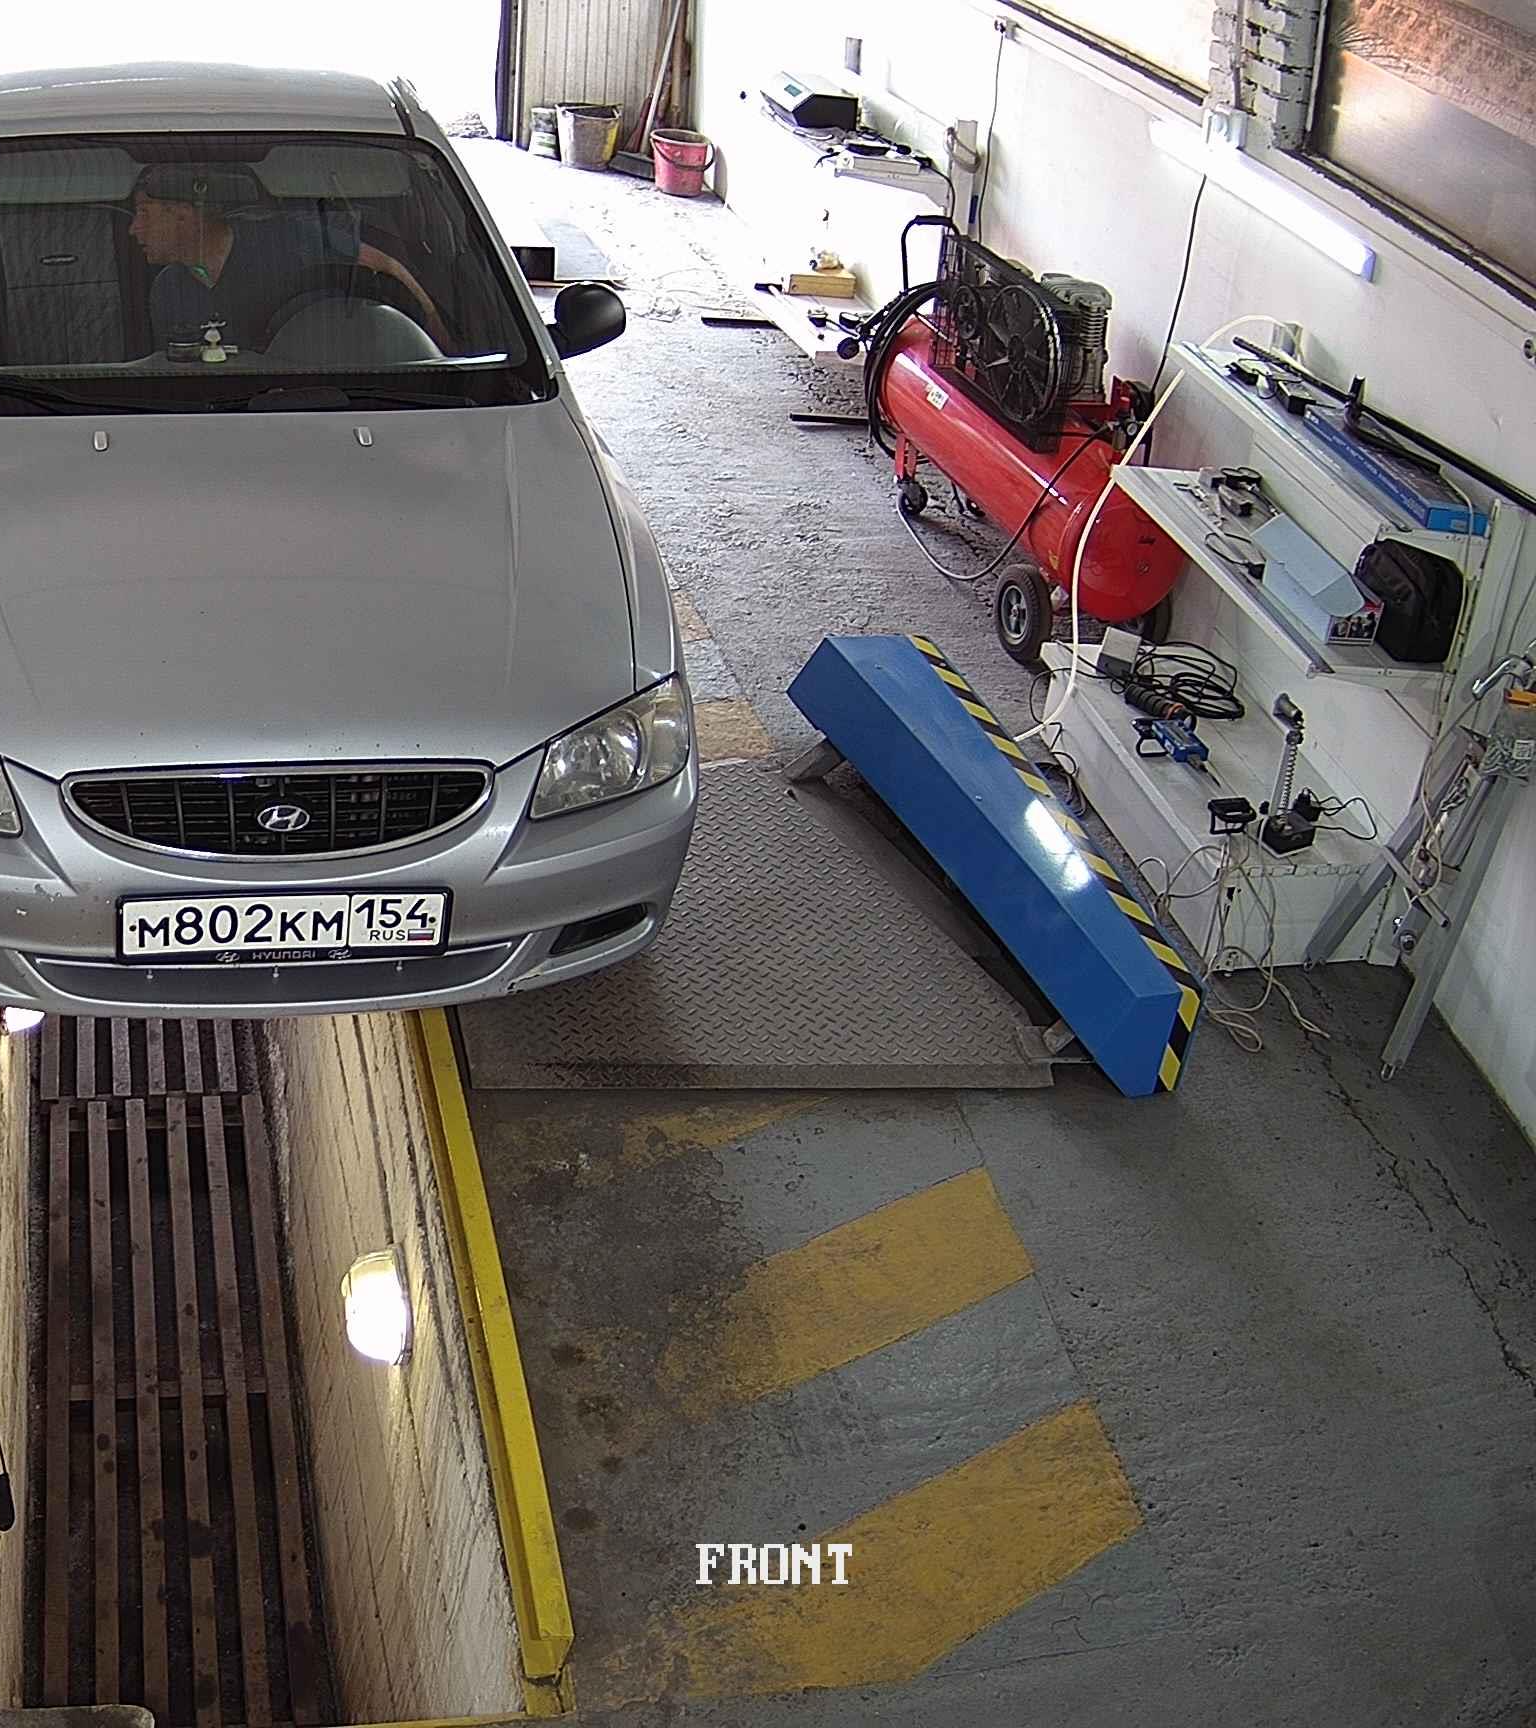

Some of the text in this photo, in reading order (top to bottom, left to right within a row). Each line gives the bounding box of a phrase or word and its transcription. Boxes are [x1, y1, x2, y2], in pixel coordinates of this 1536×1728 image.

[355, 899, 429, 929] 154
[138, 903, 345, 948] М802КМ
[370, 930, 406, 942] RUS
[252, 951, 316, 960] HYUNDAI
